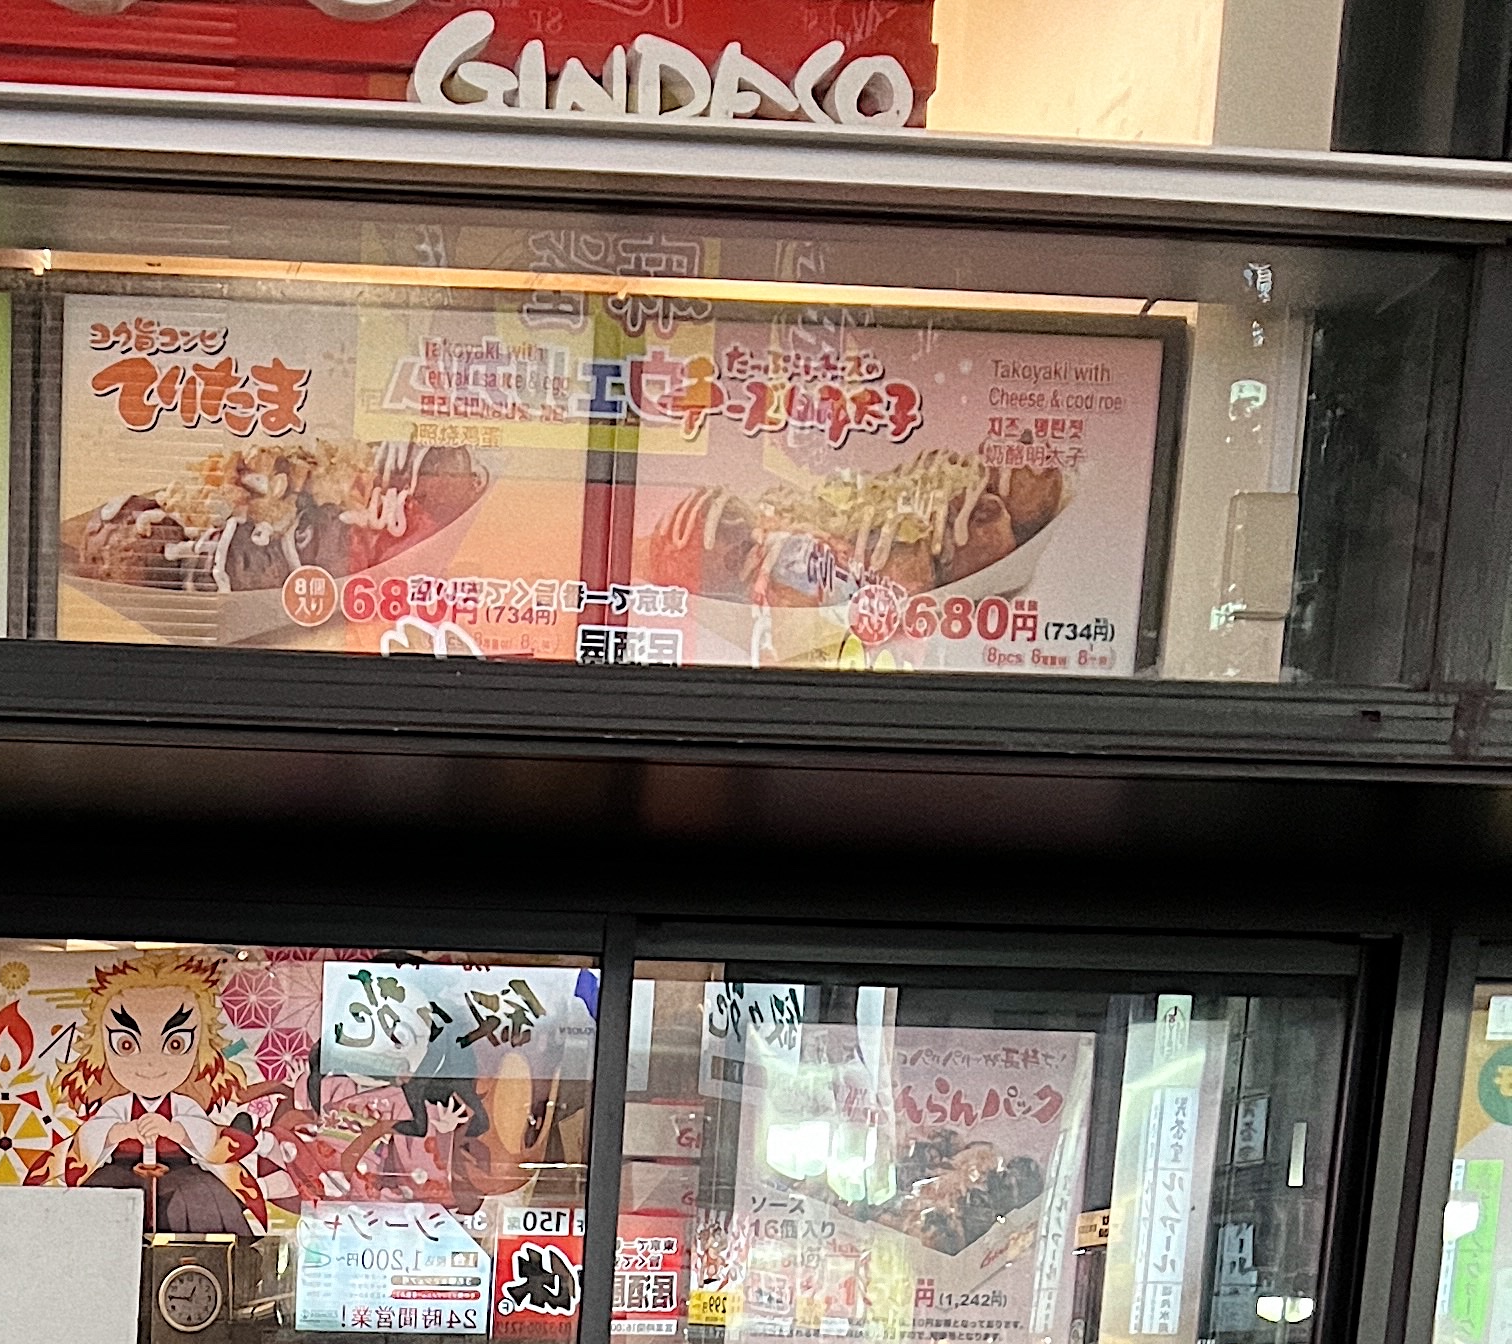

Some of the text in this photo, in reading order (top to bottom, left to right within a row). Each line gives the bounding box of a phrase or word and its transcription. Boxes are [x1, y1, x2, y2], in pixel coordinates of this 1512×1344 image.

[406, 9, 914, 128] GINDACO
[91, 356, 311, 437] てりたま
[991, 359, 1112, 384] Takoyaki with
[989, 387, 1123, 410] Cheese & cod roe
